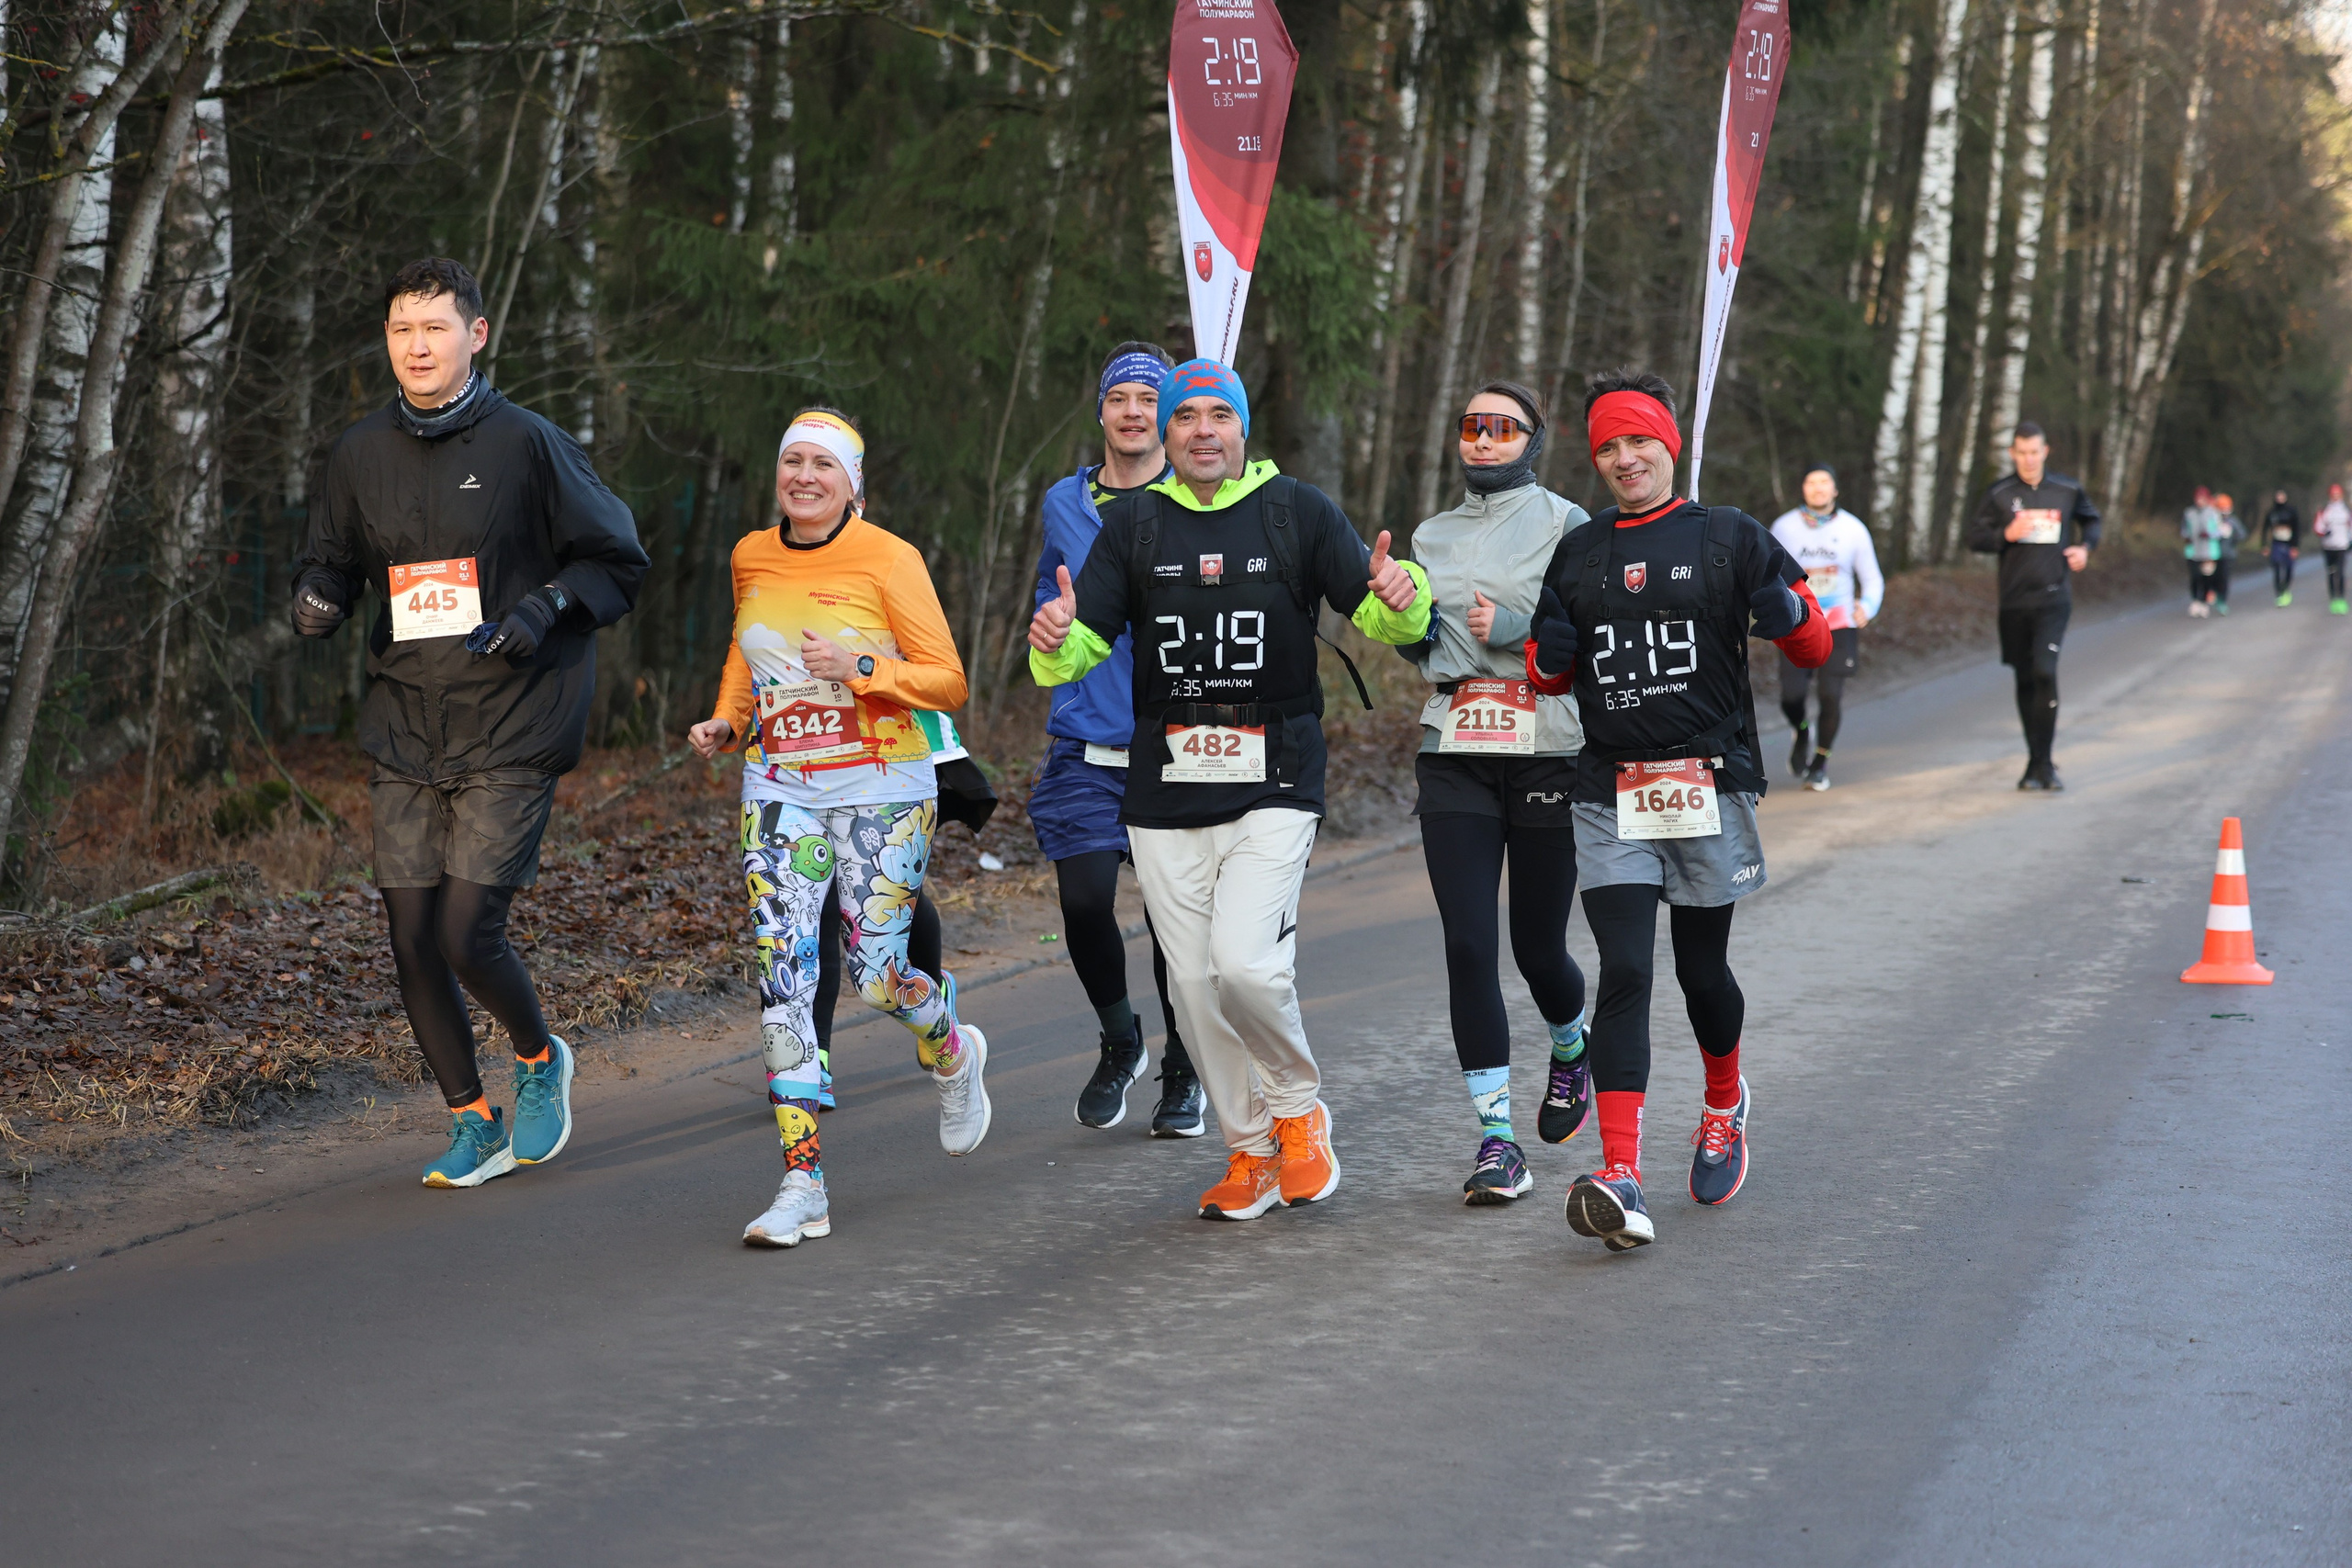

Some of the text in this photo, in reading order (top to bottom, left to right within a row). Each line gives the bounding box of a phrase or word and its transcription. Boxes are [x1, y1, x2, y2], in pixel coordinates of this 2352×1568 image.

[1200, 8, 1255, 18] ПОЛУМАРАФОН
[1202, 38, 1261, 85] 2:19
[1214, 93, 1234, 107] 6:35
[1114, 364, 1145, 377] REJLERS
[1129, 370, 1159, 378] REJLERS
[459, 561, 468, 571] G
[1248, 558, 1267, 572] GRi
[1670, 566, 1692, 580] GRi
[306, 595, 329, 612] MOAX
[408, 589, 458, 614] 445
[808, 592, 850, 602] Муринский
[486, 634, 505, 655] MOAX
[1155, 611, 1265, 673] 2:19
[1592, 619, 1698, 684] 2:19
[779, 684, 819, 695] ГАТЧИНСКИЙ
[831, 682, 840, 693] D
[1204, 679, 1252, 688] МИН/КМ
[1518, 684, 1526, 694] G
[780, 691, 820, 700] ПОЛУМАРАФОН
[1605, 682, 1688, 710] 6:35 МИН/КМ
[772, 709, 843, 739] 4342
[1455, 708, 1516, 730] 2115
[1182, 734, 1241, 757] 482
[1643, 760, 1685, 769] ГАТЧИНСКИЙ
[1634, 786, 1704, 813] 1646
